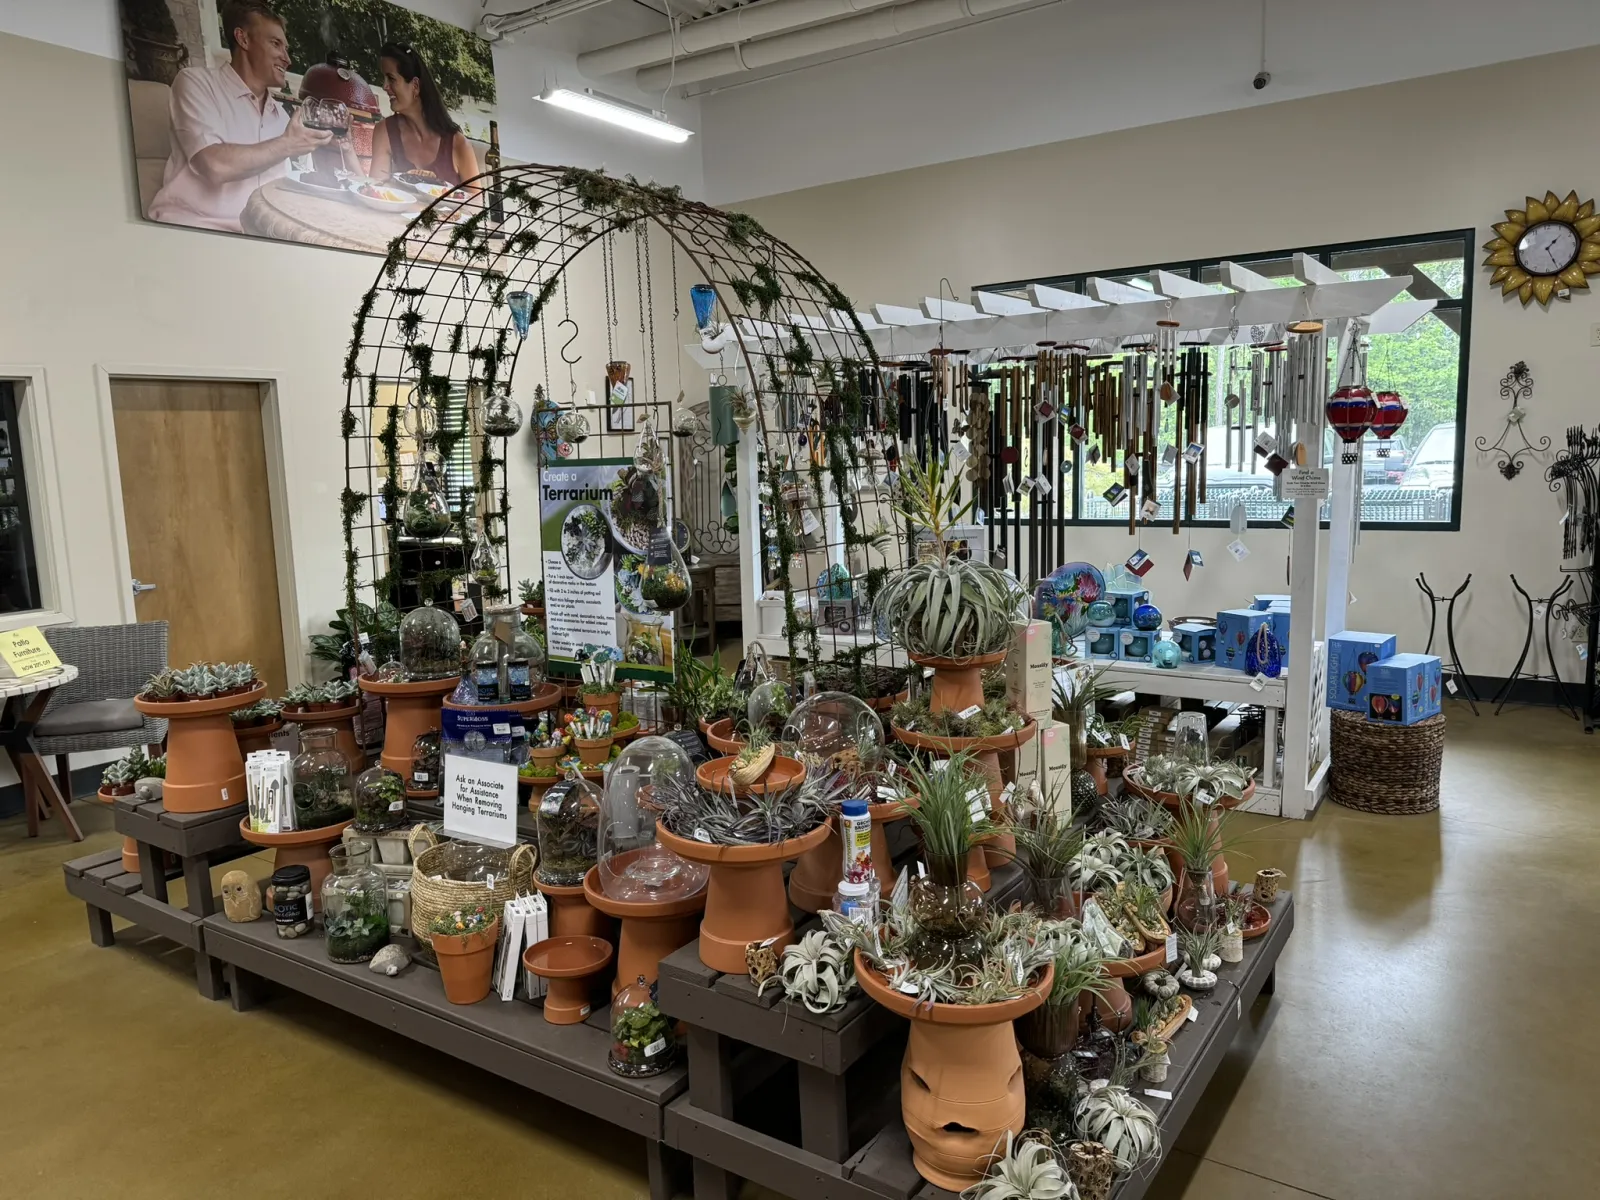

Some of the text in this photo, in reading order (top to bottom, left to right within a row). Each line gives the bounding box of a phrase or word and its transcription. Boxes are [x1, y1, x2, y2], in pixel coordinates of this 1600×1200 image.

[543, 470, 576, 482] Create a
[542, 483, 613, 500] Terrarium
[12, 639, 30, 648] Patio
[13, 647, 41, 658] Furniture
[456, 774, 466, 783] Ask
[477, 778, 504, 790] Associate
[470, 787, 498, 799] Assistance
[456, 793, 502, 811] When Removing
[452, 801, 507, 820] Hanging Terrariums
